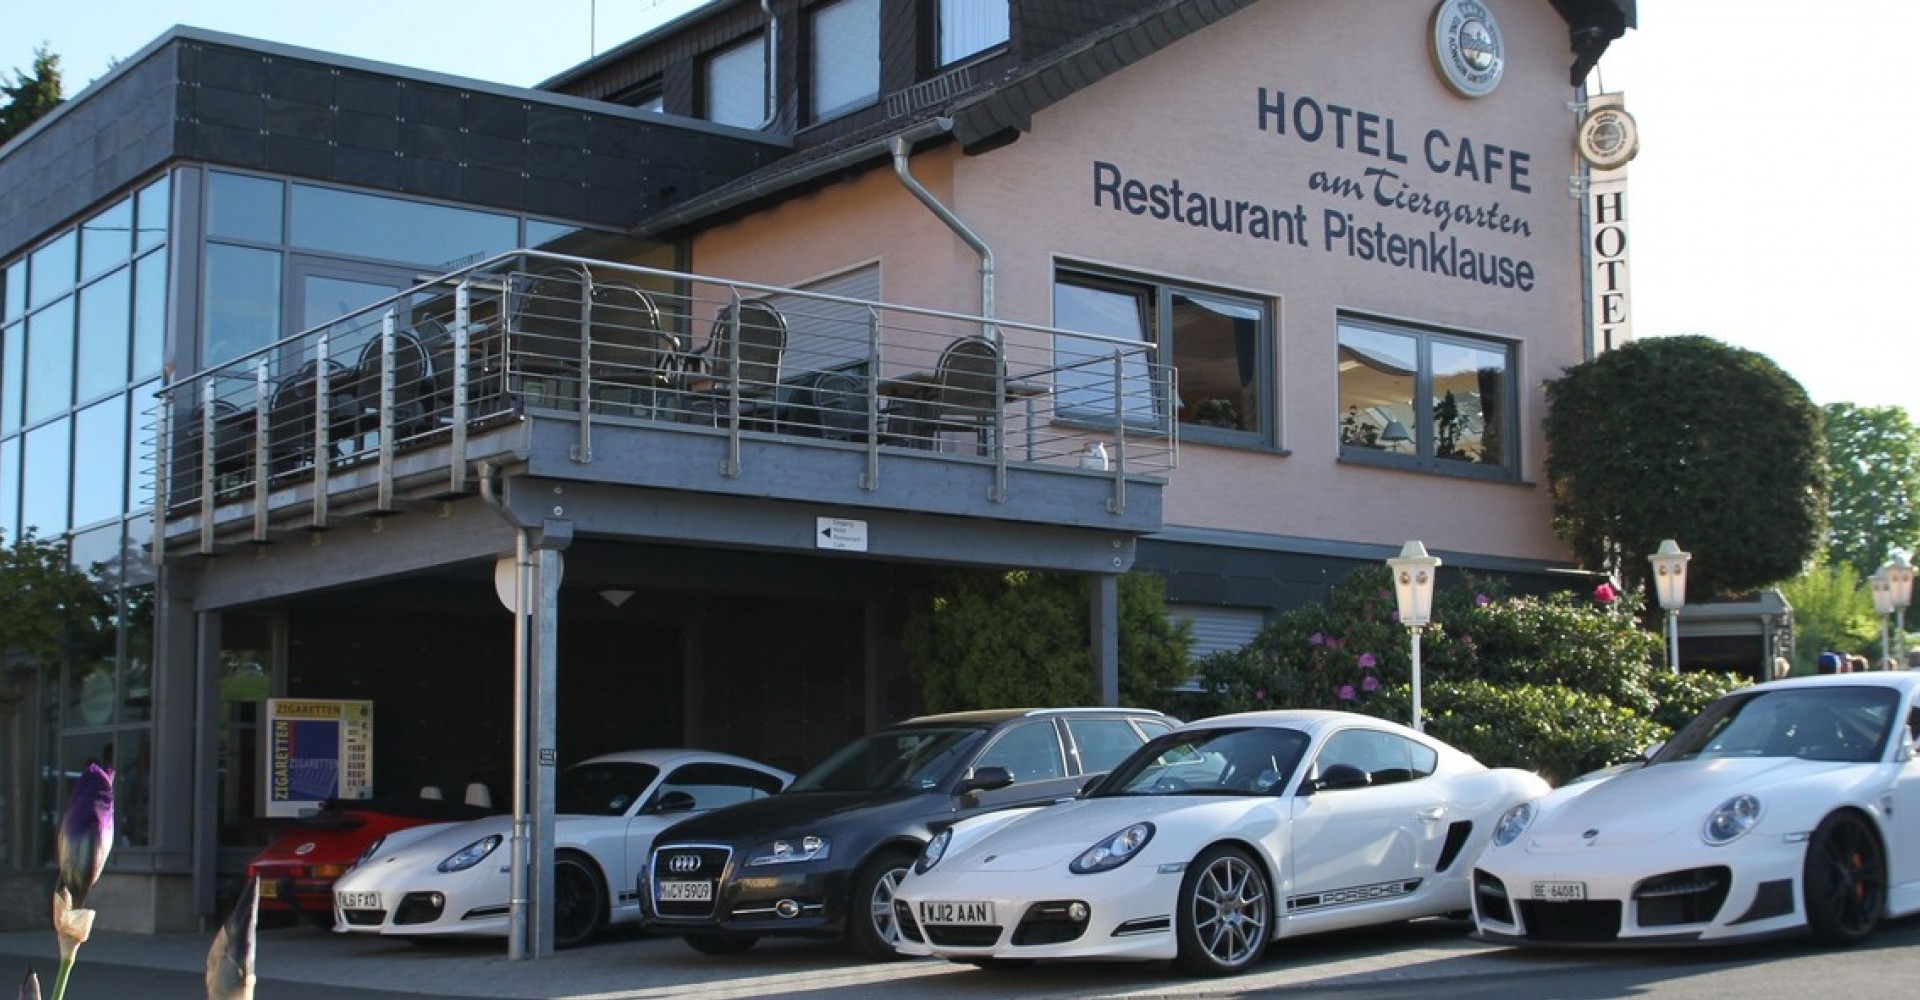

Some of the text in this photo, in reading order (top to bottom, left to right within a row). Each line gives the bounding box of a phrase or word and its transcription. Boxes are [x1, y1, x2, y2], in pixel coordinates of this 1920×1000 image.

[1257, 87, 1408, 164] HOTEL
[1424, 129, 1532, 194] CAFE
[1093, 160, 1535, 292] Restaurant Pistenklause
[1308, 167, 1532, 237] am Tiergarten
[276, 703, 341, 715] ZIGARETTEN
[275, 720, 289, 800] ZIGARETTEN
[957, 903, 987, 922] AAN
[1322, 884, 1400, 904] PORSCHE
